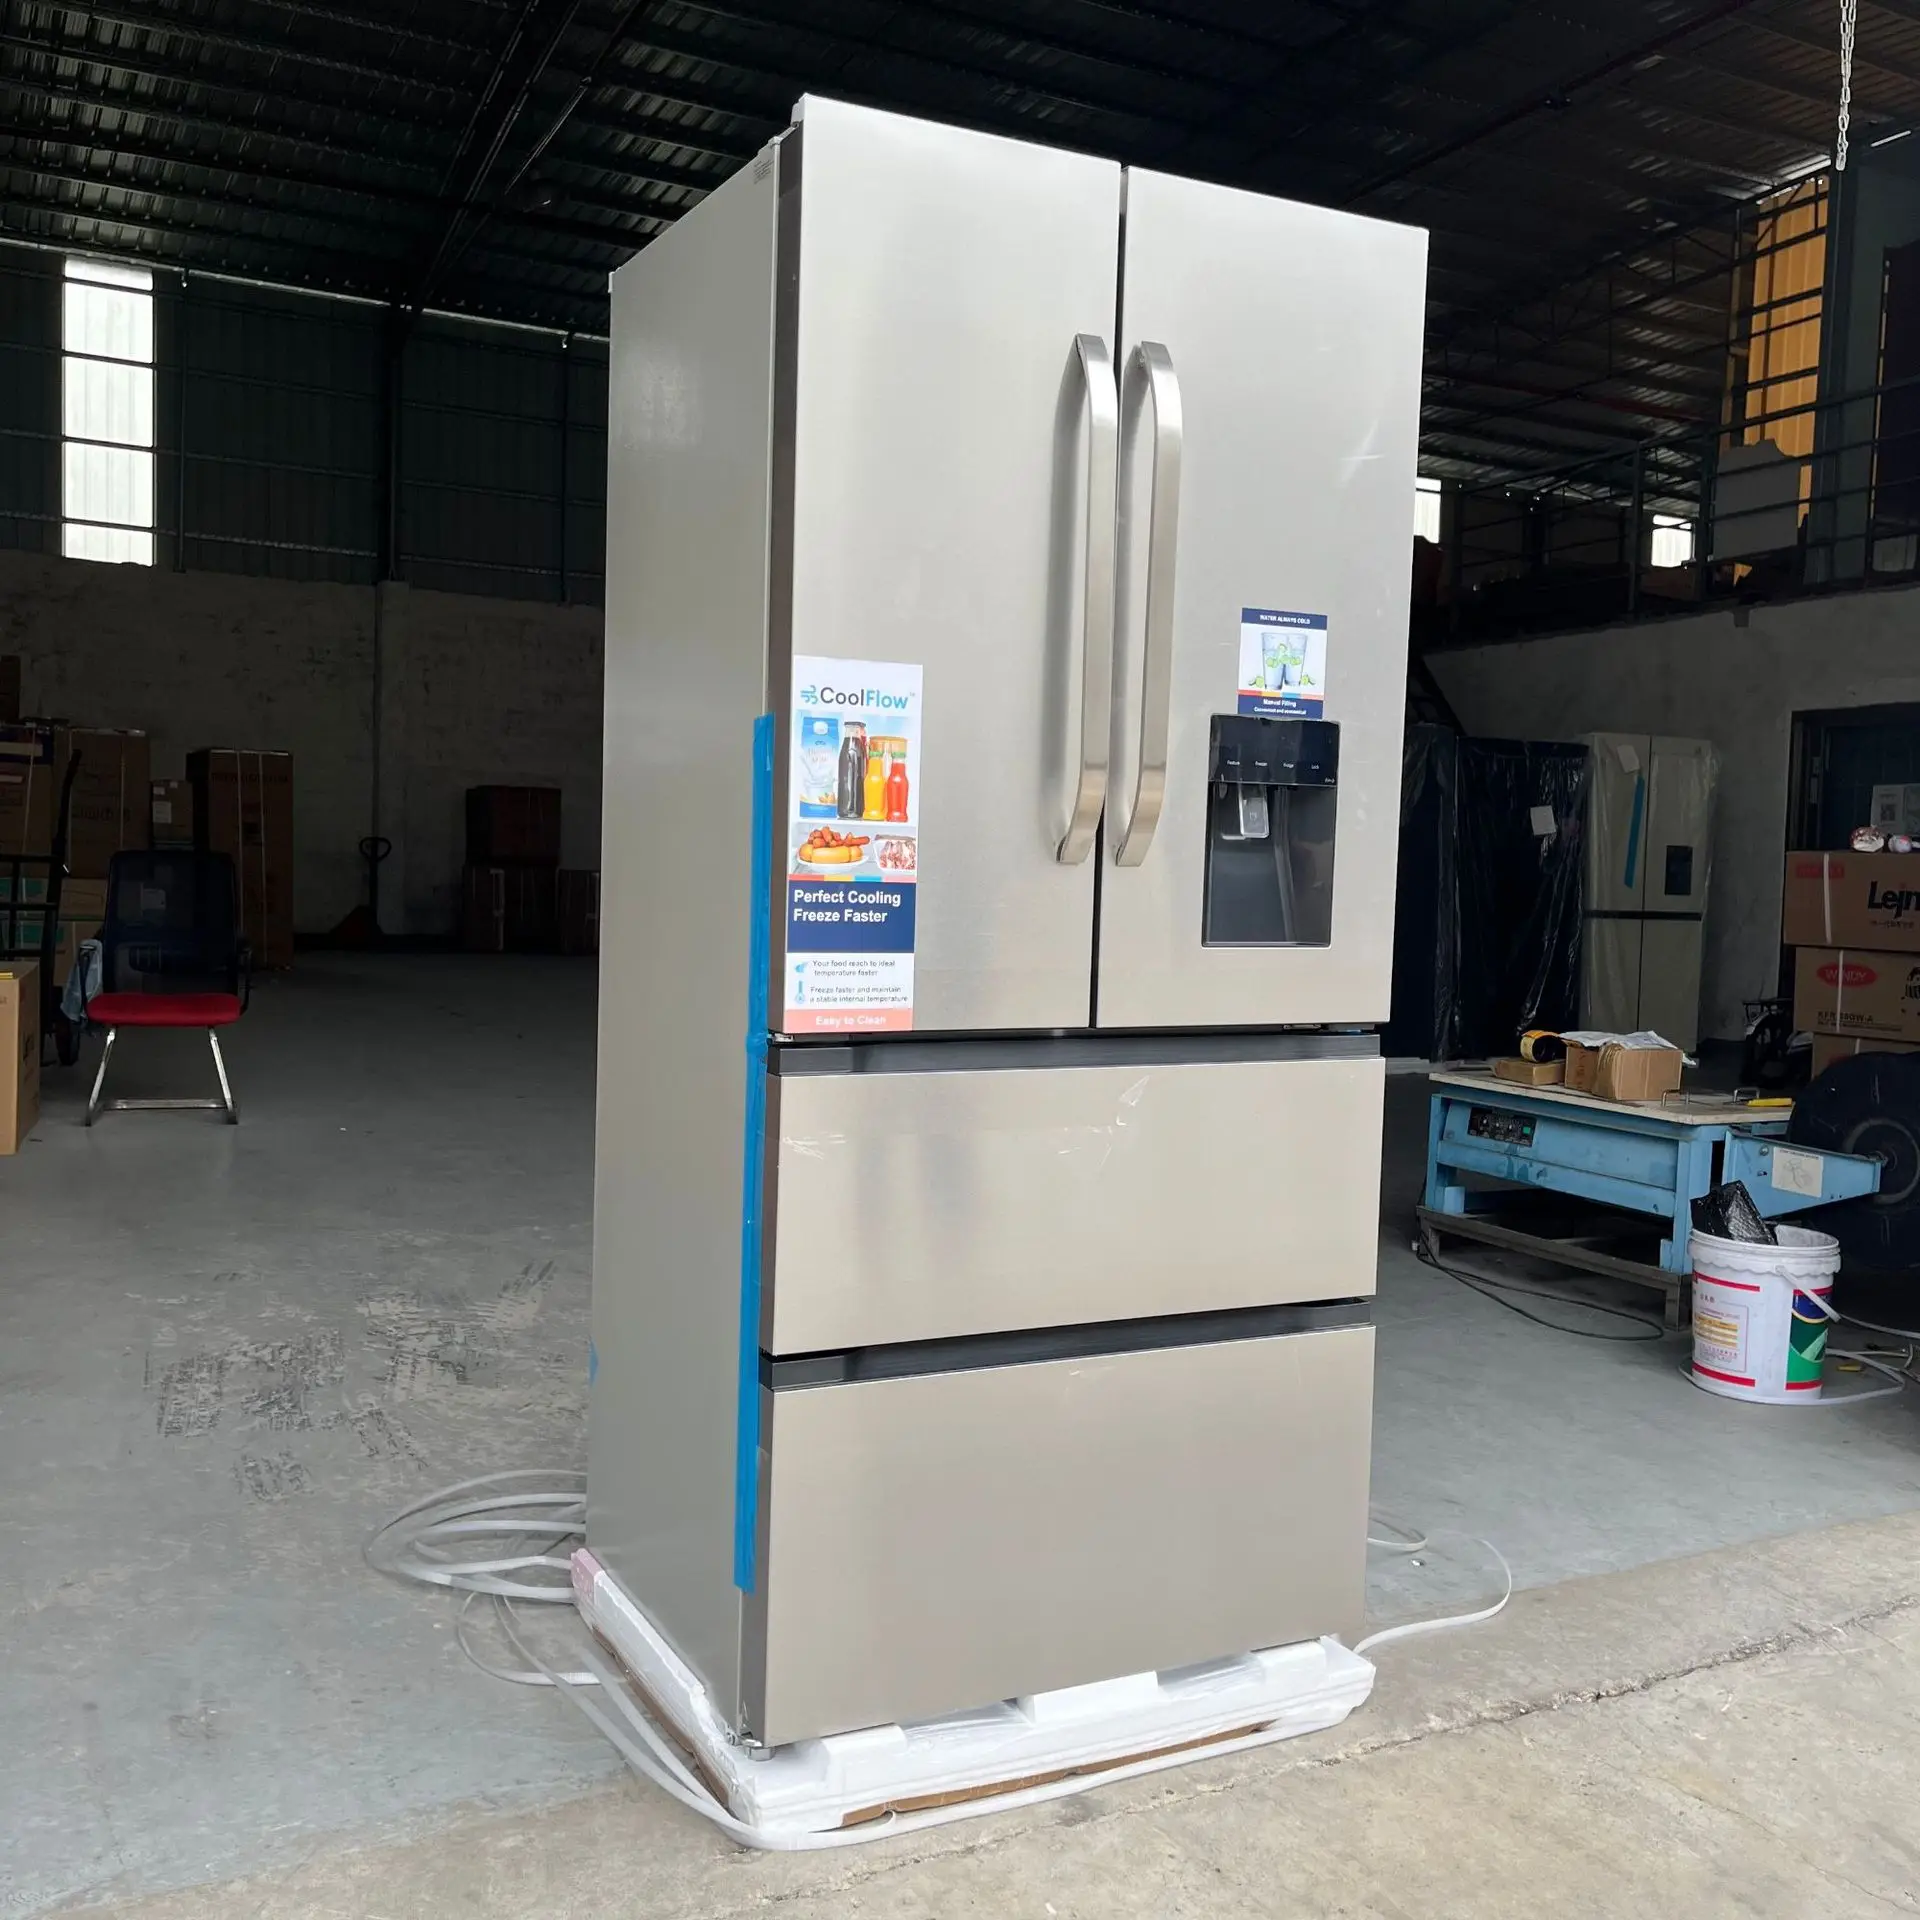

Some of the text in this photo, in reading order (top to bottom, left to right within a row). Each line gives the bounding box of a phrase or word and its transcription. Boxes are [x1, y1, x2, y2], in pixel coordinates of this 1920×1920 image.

[1277, 616, 1297, 624] ALWAYS
[1297, 617, 1311, 625] COLD
[820, 686, 909, 709] CoolFlow
[794, 889, 901, 907] Perfect Cooling
[793, 908, 888, 923] Freeze Faster
[1824, 969, 1867, 980] WNDY
[810, 986, 833, 994] Freeze
[835, 986, 855, 994] faster
[867, 996, 908, 1004] temperature
[815, 1015, 887, 1028] Easy to Clean
